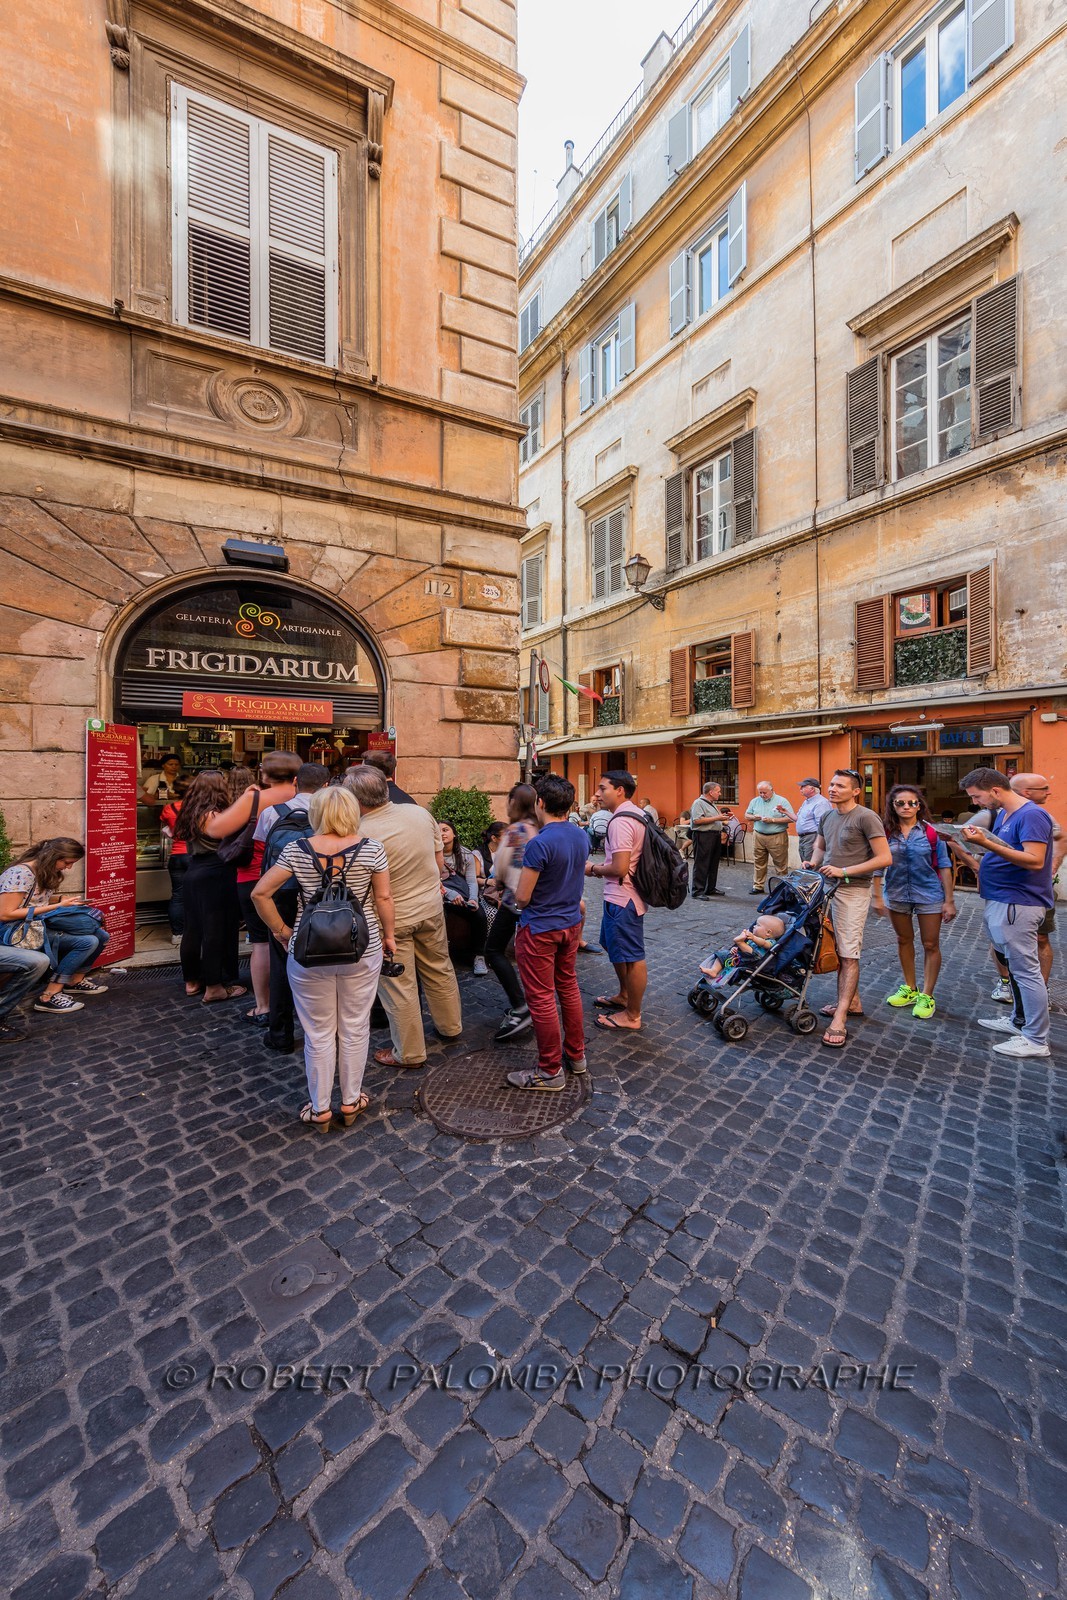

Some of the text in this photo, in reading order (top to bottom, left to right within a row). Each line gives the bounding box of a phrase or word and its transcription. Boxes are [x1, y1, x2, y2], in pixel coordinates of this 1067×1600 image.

[427, 580, 452, 596] 112
[175, 612, 233, 626] GELATERIA
[281, 624, 342, 637] ARTIGIANALE
[145, 647, 361, 683] FRIGIDARIUM
[223, 695, 325, 713] FRIGIDARIUM
[862, 730, 983, 748] PIZZERIA BAFFE
